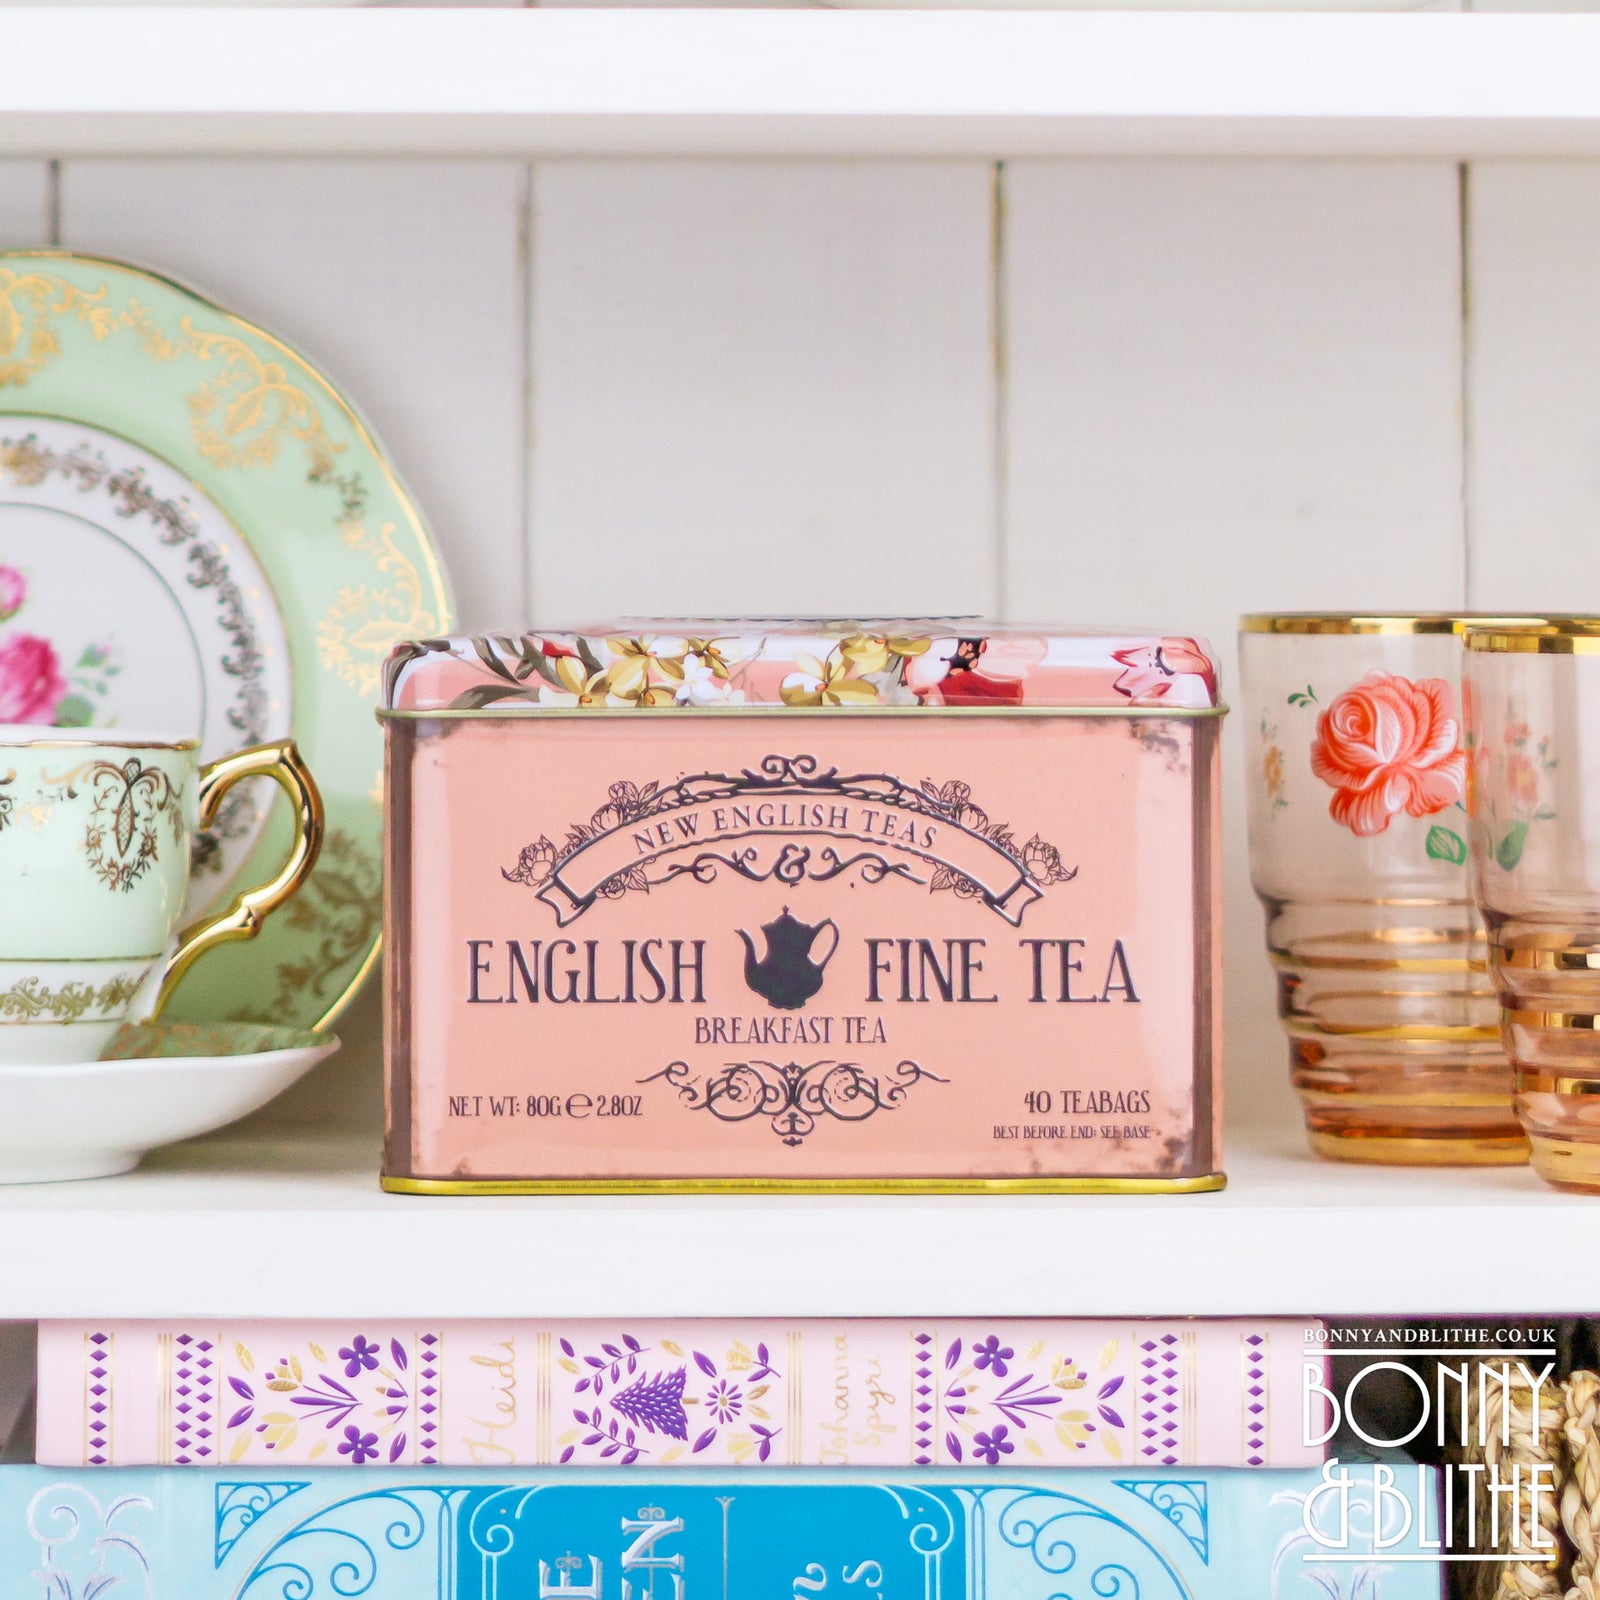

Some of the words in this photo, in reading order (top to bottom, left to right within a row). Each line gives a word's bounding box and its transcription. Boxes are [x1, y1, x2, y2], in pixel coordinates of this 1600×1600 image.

[632, 812, 699, 854] NEW
[713, 803, 849, 830] ENGLISH
[861, 809, 938, 849] TEAS
[466, 938, 707, 1003] ENGLISH
[863, 938, 998, 1003] FINE
[1018, 938, 1141, 1003] TEA
[694, 1016, 833, 1044] BREAKFAST
[842, 1016, 887, 1044] TEA
[448, 1095, 482, 1117] NET
[489, 1095, 521, 1117] WT:
[1024, 1090, 1052, 1114] 40
[1060, 1090, 1151, 1114] TEABAGS
[993, 1125, 1020, 1139] BEST
[1023, 1125, 1067, 1139] BEFORE
[1070, 1125, 1097, 1139] END:
[1101, 1125, 1120, 1139] SEE
[1123, 1125, 1151, 1139] BASE
[462, 1335, 517, 1464] Heidi
[817, 1331, 849, 1465] Johanna
[851, 1354, 898, 1448] Spyri
